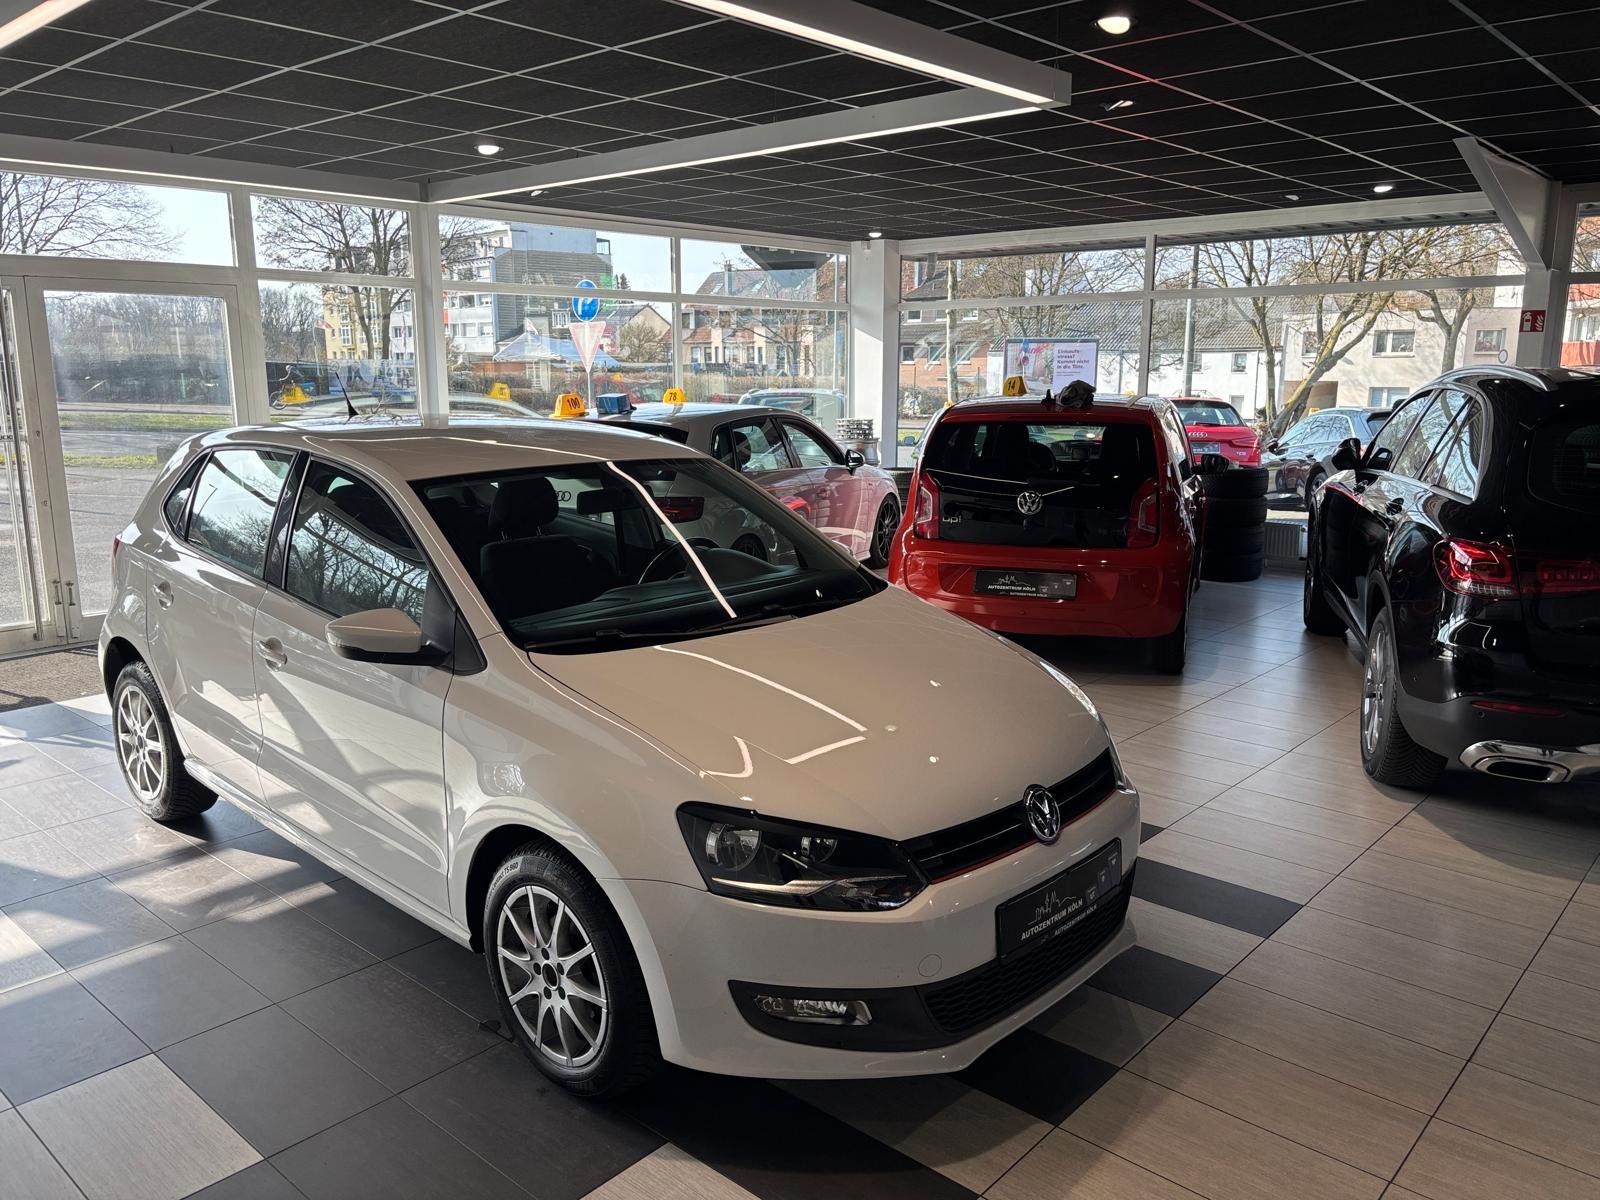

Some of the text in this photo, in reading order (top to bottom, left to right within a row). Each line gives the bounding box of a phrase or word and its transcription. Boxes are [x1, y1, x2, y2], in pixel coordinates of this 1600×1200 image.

[1008, 380, 1016, 391] 14
[669, 392, 677, 401] 78
[567, 397, 581, 410] 100
[1020, 898, 1084, 941] AUTOZENTRUM KÖLN
